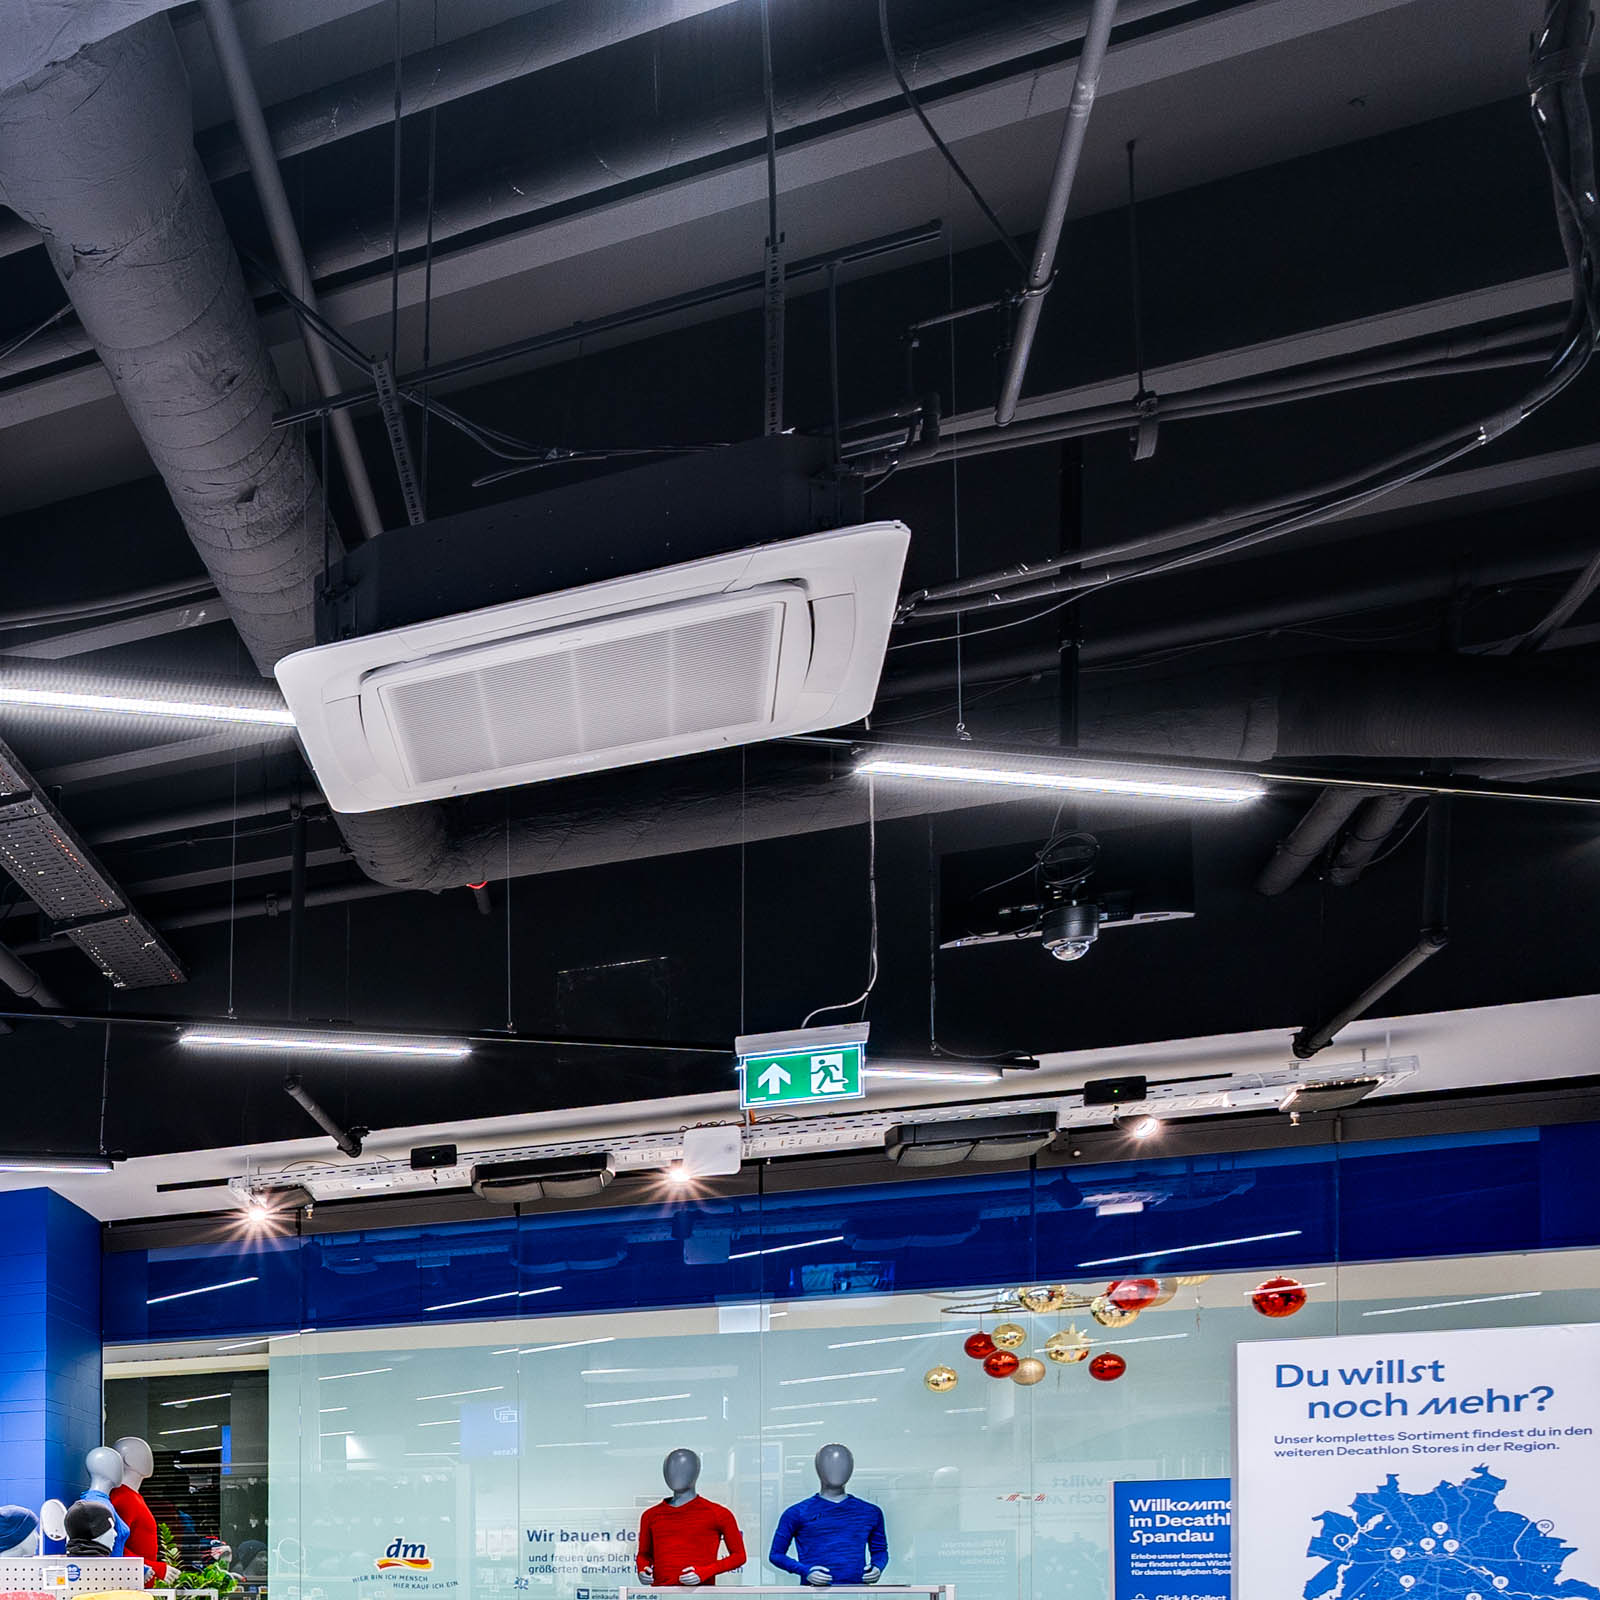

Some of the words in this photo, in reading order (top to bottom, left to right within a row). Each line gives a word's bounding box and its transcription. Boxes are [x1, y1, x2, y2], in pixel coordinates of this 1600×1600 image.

[1275, 1363, 1329, 1389] Du
[1337, 1359, 1446, 1386] willst
[1309, 1392, 1407, 1418] noch
[1418, 1386, 1554, 1415] mehr?
[1273, 1435, 1315, 1445] Unser
[1315, 1432, 1396, 1445] komplettes
[1397, 1430, 1471, 1441] Sortiment
[1471, 1428, 1525, 1439] findest
[1525, 1427, 1547, 1438] du
[1548, 1426, 1563, 1437] in
[1563, 1425, 1593, 1437] den
[1273, 1447, 1335, 1458] weiteren
[1336, 1445, 1410, 1456] Decathlon
[1411, 1443, 1460, 1455] Stores
[1461, 1442, 1475, 1453] in
[1476, 1442, 1503, 1453] der
[1503, 1440, 1561, 1454] Region.
[1129, 1498, 1232, 1513] Willkomme
[1129, 1514, 1153, 1528] im
[1155, 1511, 1232, 1527] Decathl
[526, 1529, 555, 1543] Wir
[559, 1529, 611, 1543] bauen
[615, 1528, 637, 1543] de
[1129, 1528, 1215, 1547] Spandau
[384, 1537, 427, 1560] dm
